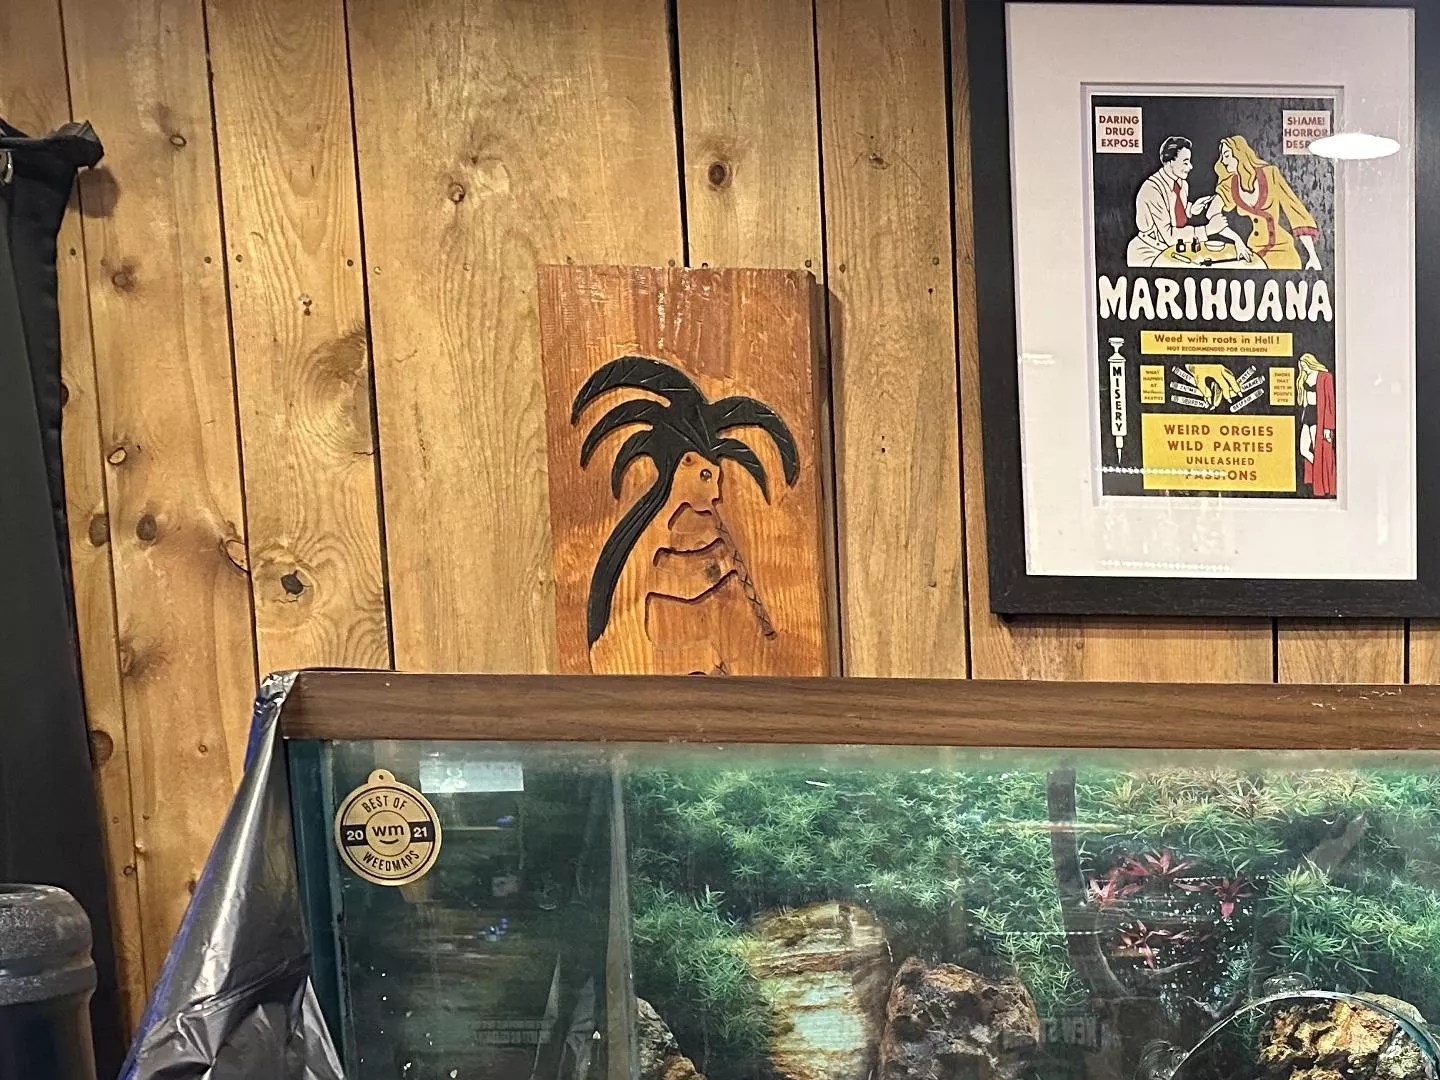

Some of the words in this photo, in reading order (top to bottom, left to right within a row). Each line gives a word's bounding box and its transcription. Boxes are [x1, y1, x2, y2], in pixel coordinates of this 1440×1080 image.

[1098, 115, 1140, 124] DARING
[1287, 116, 1326, 126] SHAME!
[1105, 127, 1134, 136] DRUG
[1284, 128, 1329, 137] HORROR
[1101, 138, 1140, 147] EXPOSE
[1286, 140, 1311, 149] DESP
[1098, 275, 1333, 322] MARIHUANA
[1154, 334, 1183, 343] Weed
[1187, 334, 1208, 343] with
[1212, 336, 1237, 344] roots
[1241, 335, 1250, 344] in
[1112, 366, 1123, 431] MISERY
[1164, 424, 1211, 435] WEIRD
[1219, 425, 1274, 437] ORGIES
[1167, 440, 1204, 451] WILD
[1213, 441, 1273, 453] PARTIES
[1186, 456, 1255, 466] UNLEASHED
[362, 795, 389, 813] BEST
[393, 797, 408, 811] OF
[346, 830, 364, 841] 20
[372, 824, 405, 837] wm
[413, 827, 428, 838] 21
[362, 850, 420, 872] WEEDMAPS
